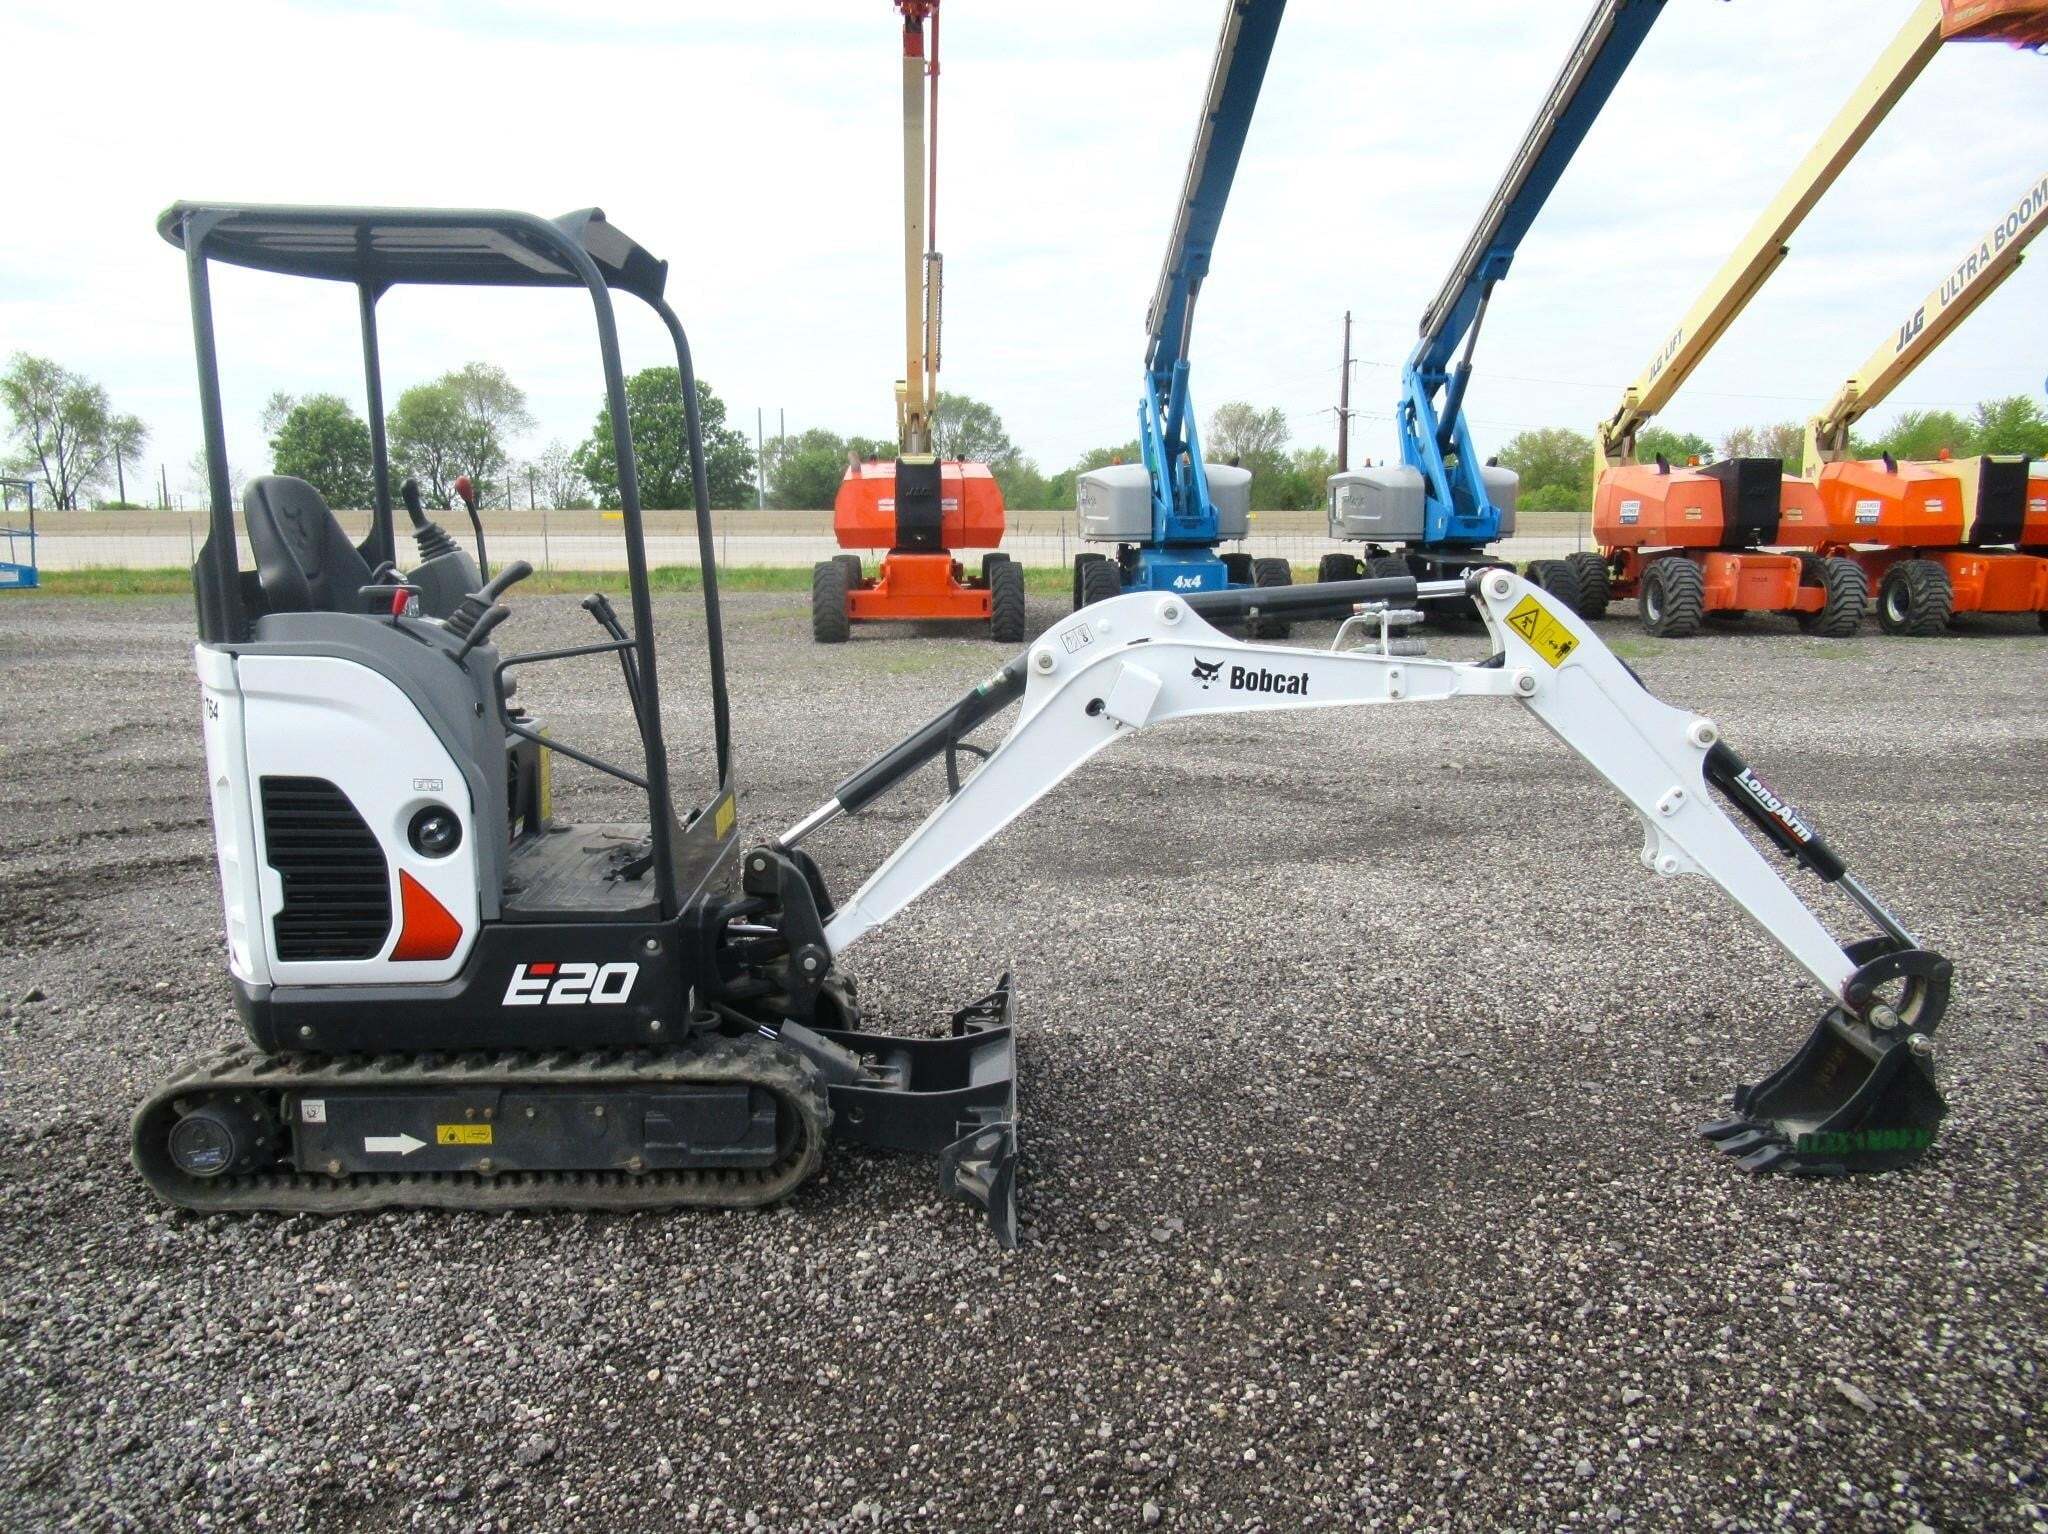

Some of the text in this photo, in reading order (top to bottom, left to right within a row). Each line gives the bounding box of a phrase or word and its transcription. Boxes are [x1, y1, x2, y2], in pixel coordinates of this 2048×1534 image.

[1896, 177, 2048, 352] JLG ULTRA BOOM
[1649, 327, 1683, 382] JLG LIFT
[1173, 575, 1201, 588] 4x4
[1229, 665, 1309, 696] Bobcat
[1737, 767, 1812, 842] LongArm
[501, 962, 640, 1006] E20
